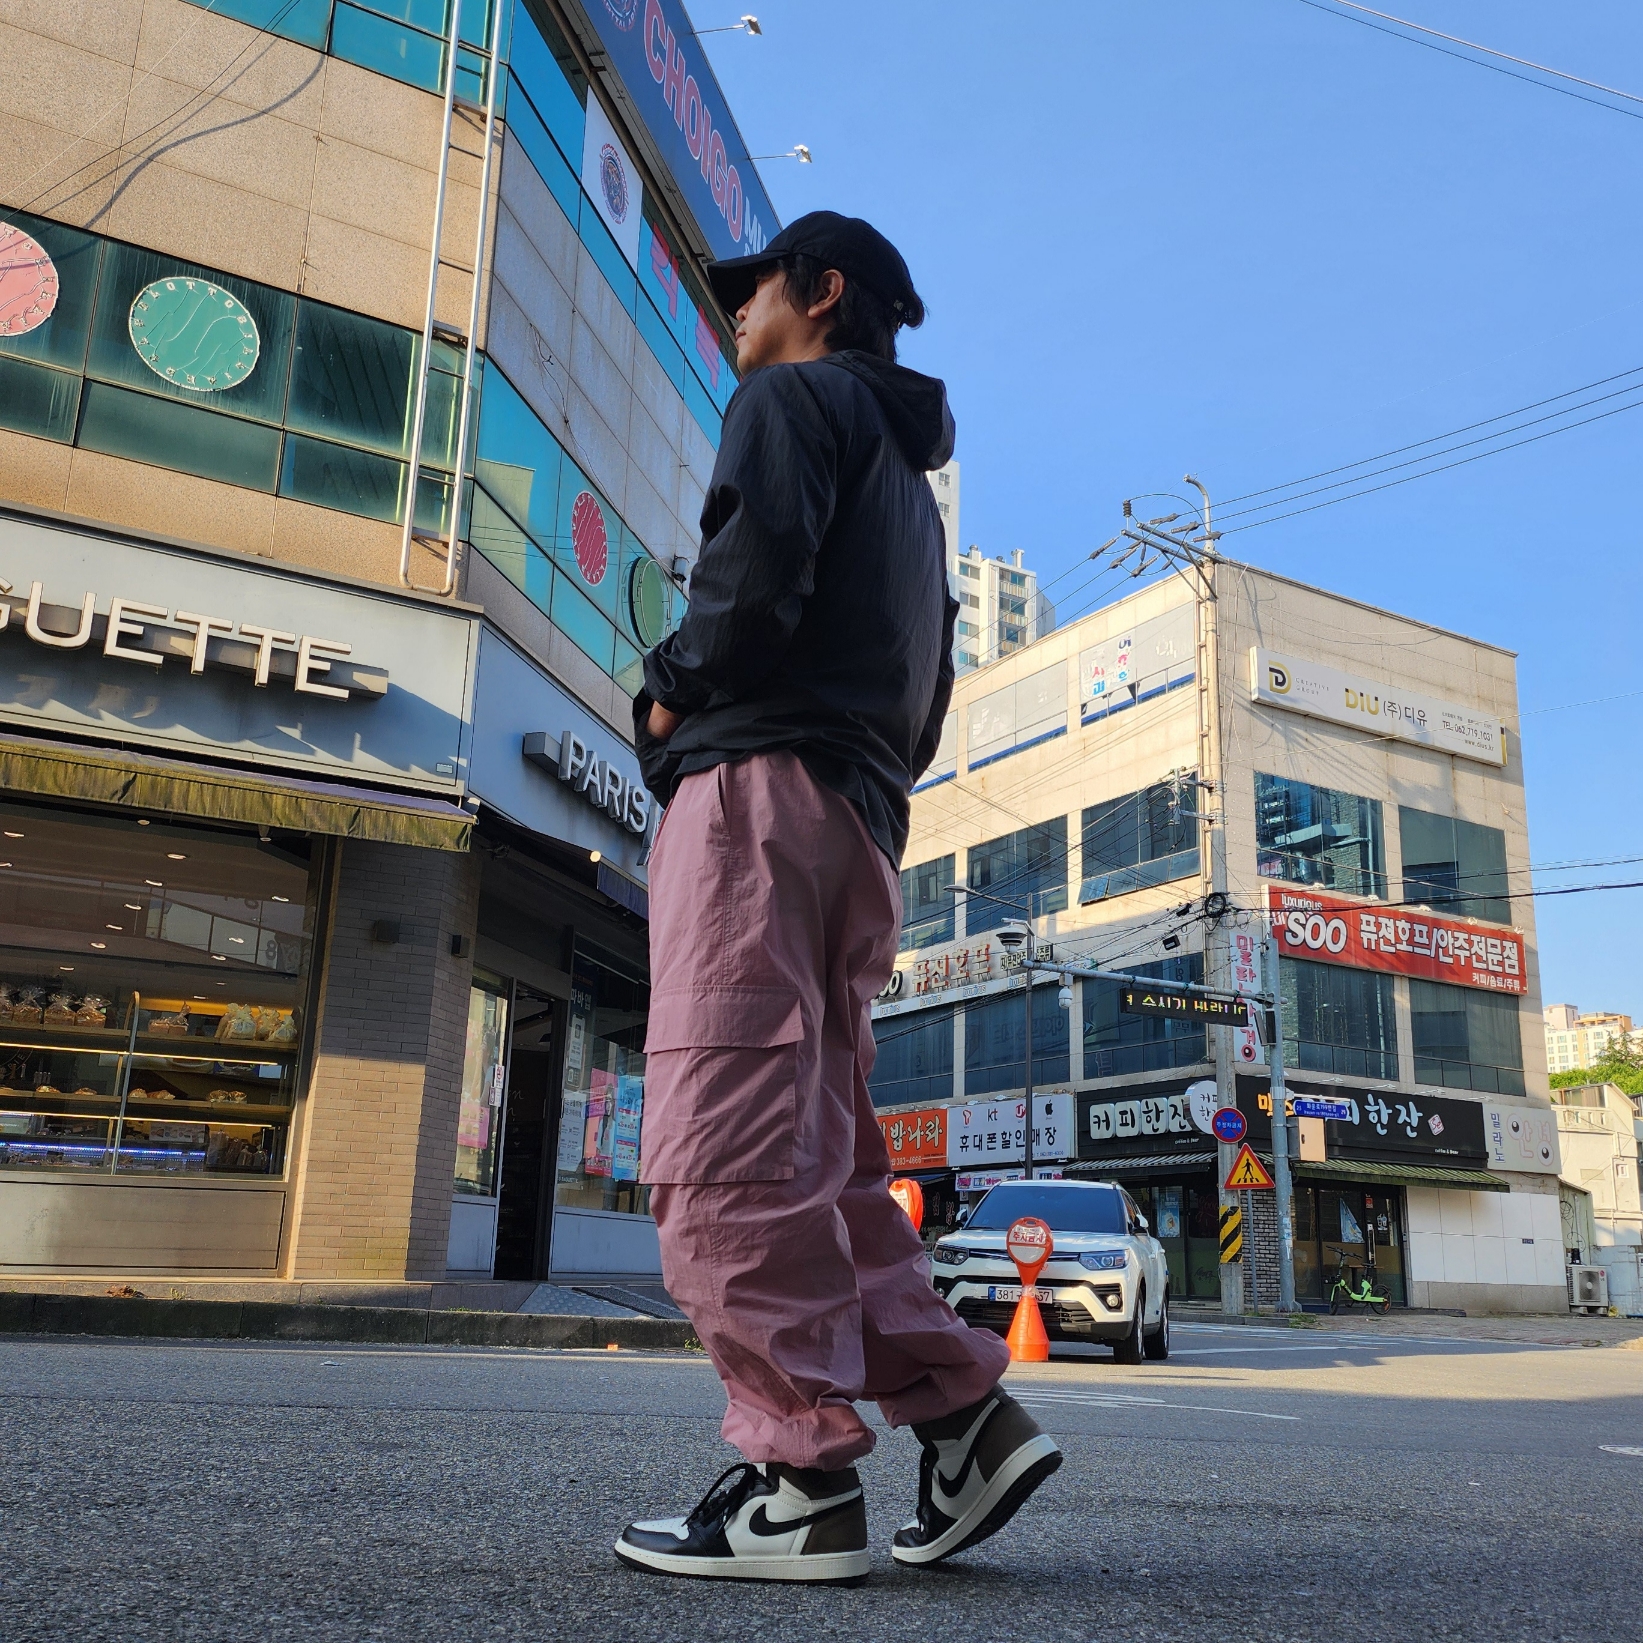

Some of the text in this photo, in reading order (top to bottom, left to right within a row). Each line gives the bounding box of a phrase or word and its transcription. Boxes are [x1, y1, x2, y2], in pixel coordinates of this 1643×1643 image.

[644, 0, 743, 243] CHOIGO
[147, 281, 235, 310] LOTTO
[558, 730, 648, 833] PARIS
[1281, 893, 1323, 911] luxurious
[1284, 911, 1347, 954] SOO
[987, 1107, 998, 1122] kt
[1216, 1121, 1242, 1129] 주정차금지
[881, 1114, 943, 1152] 밥나라
[1490, 1112, 1505, 1163] 밀라노
[1036, 1291, 1050, 1302] 57
